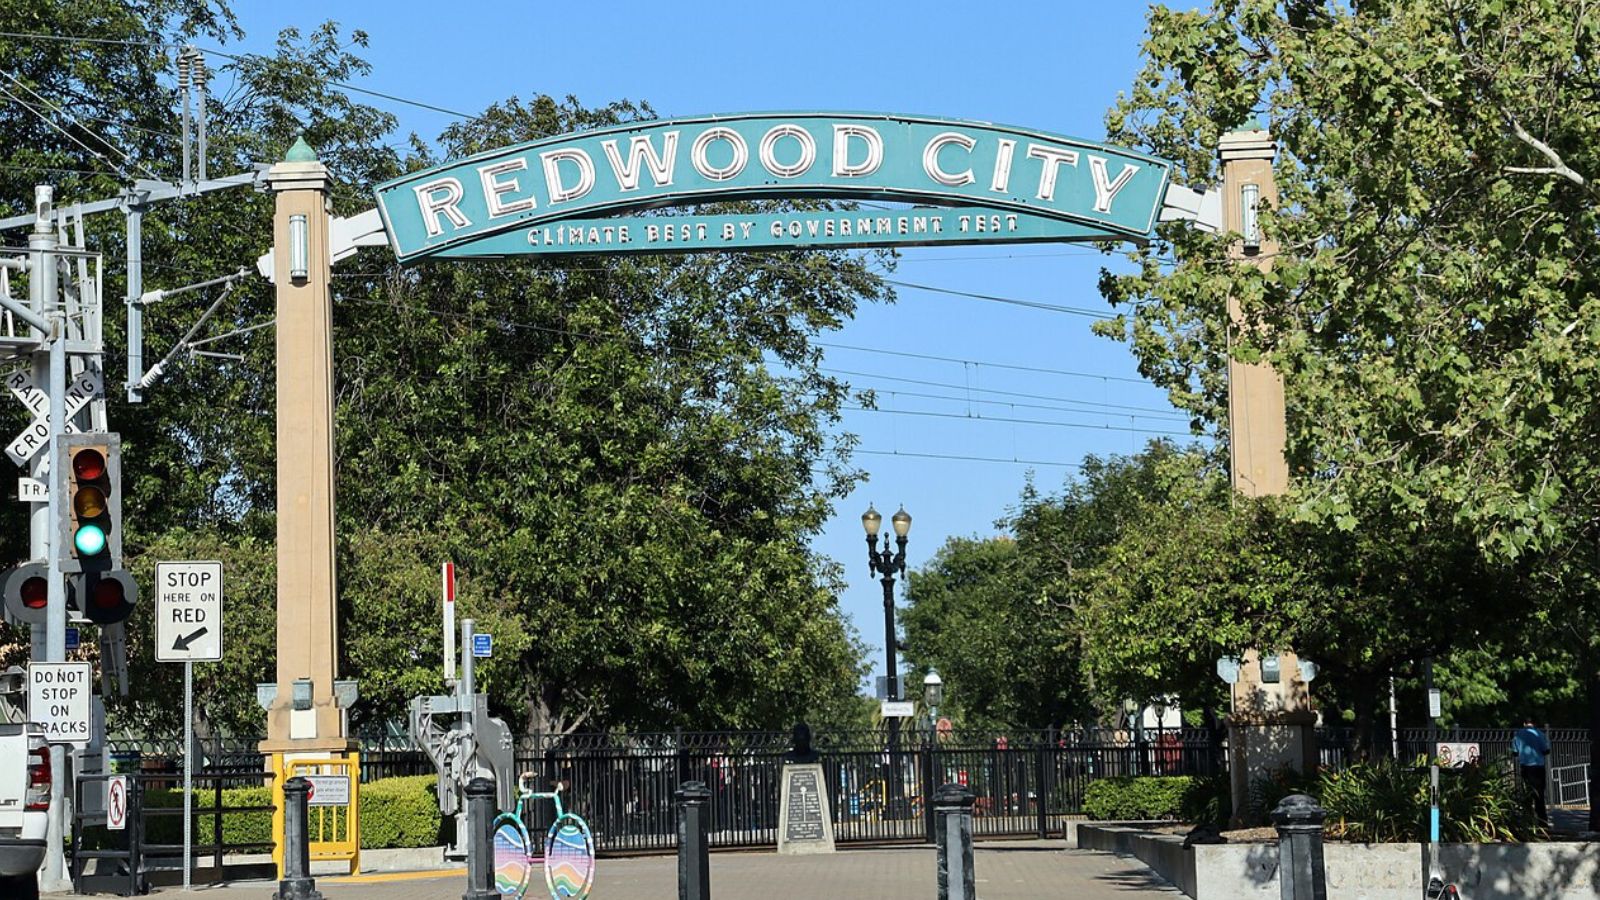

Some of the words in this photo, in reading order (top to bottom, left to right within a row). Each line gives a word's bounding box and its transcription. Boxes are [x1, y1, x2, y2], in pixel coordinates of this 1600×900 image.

[412, 122, 885, 239] REDWOOD
[922, 131, 1141, 215] CITY
[527, 223, 633, 246] CLIMATE
[647, 222, 708, 242] BEST
[722, 221, 757, 240] BY
[771, 216, 943, 239] GOVERNMENT
[959, 214, 1019, 233] TEST
[10, 373, 44, 413] RAIL
[14, 379, 94, 458] CROING
[167, 572, 212, 588] STOP
[163, 592, 191, 603] HERE
[200, 592, 216, 603] ON
[172, 608, 206, 623] RED
[35, 672, 53, 683] DO
[57, 671, 84, 683] NOT
[42, 688, 78, 700] STOP
[50, 705, 69, 717] ON
[41, 722, 87, 734] RACKS
